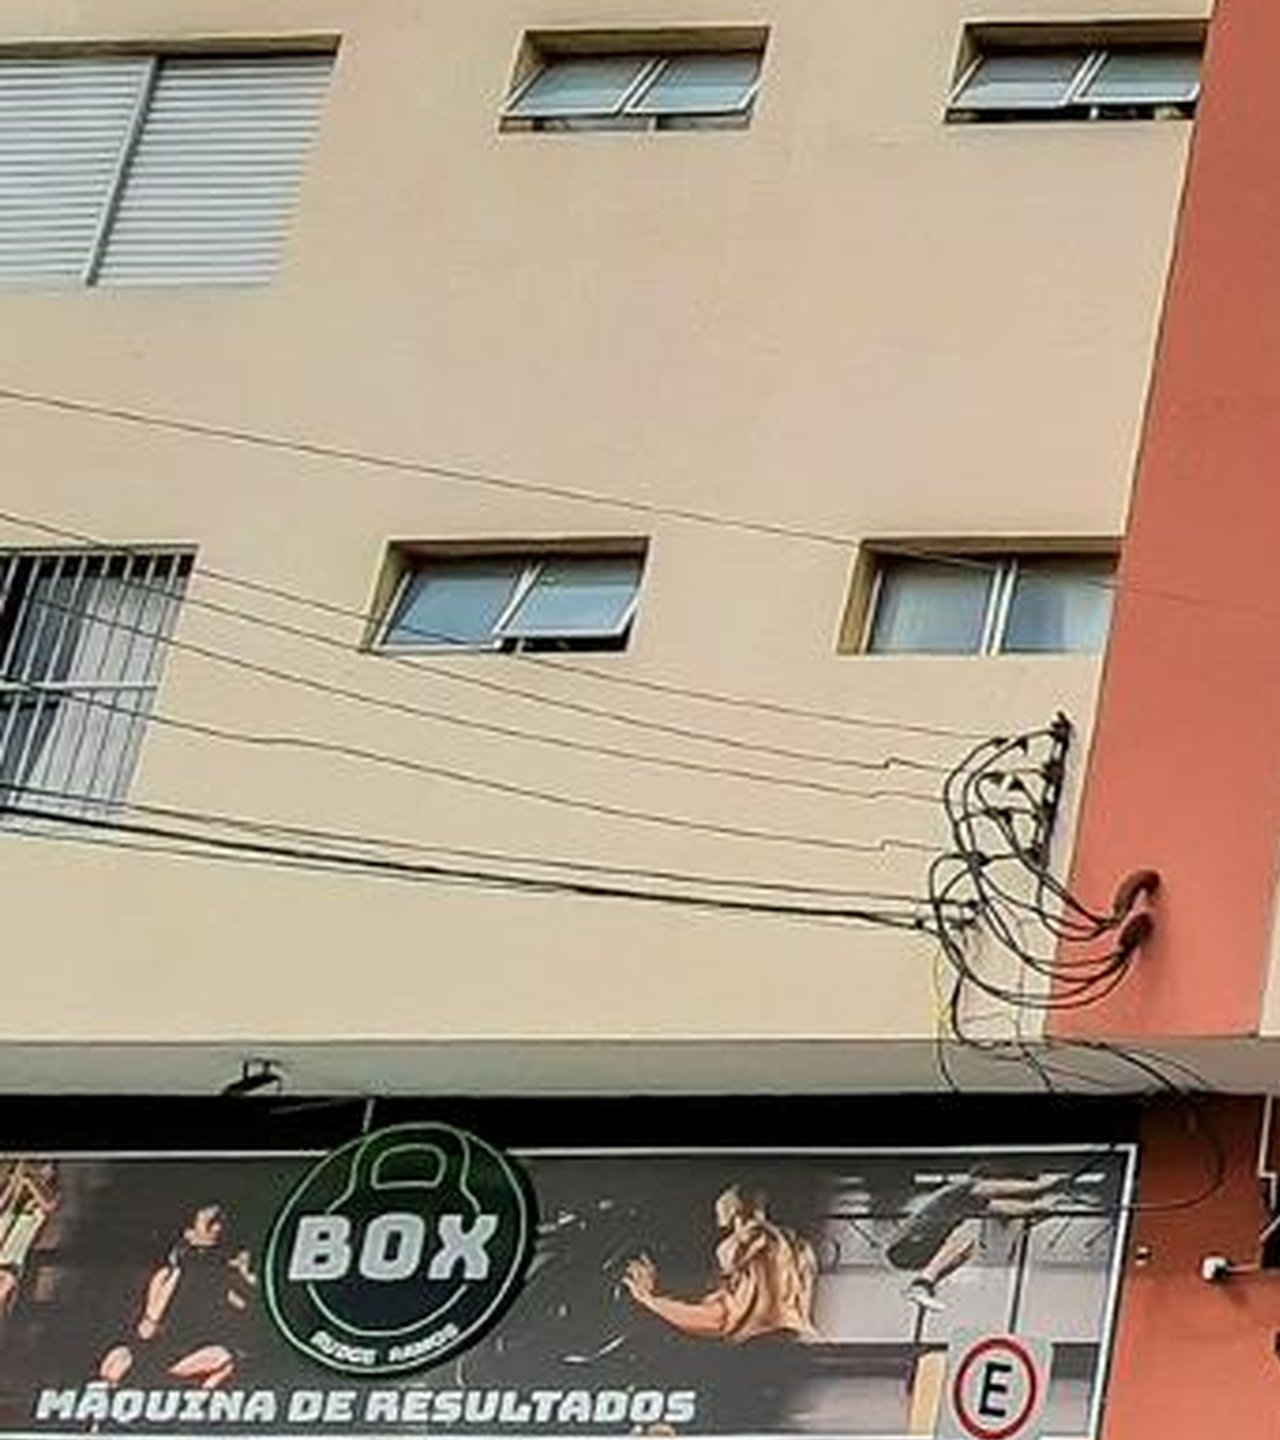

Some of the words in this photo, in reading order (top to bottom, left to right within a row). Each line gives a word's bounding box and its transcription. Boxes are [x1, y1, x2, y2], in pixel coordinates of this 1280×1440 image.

[288, 1213, 498, 1281] BOX
[287, 1390, 357, 1422] DE
[365, 1388, 697, 1422] RESULTADOS
[979, 1362, 1012, 1417] E
